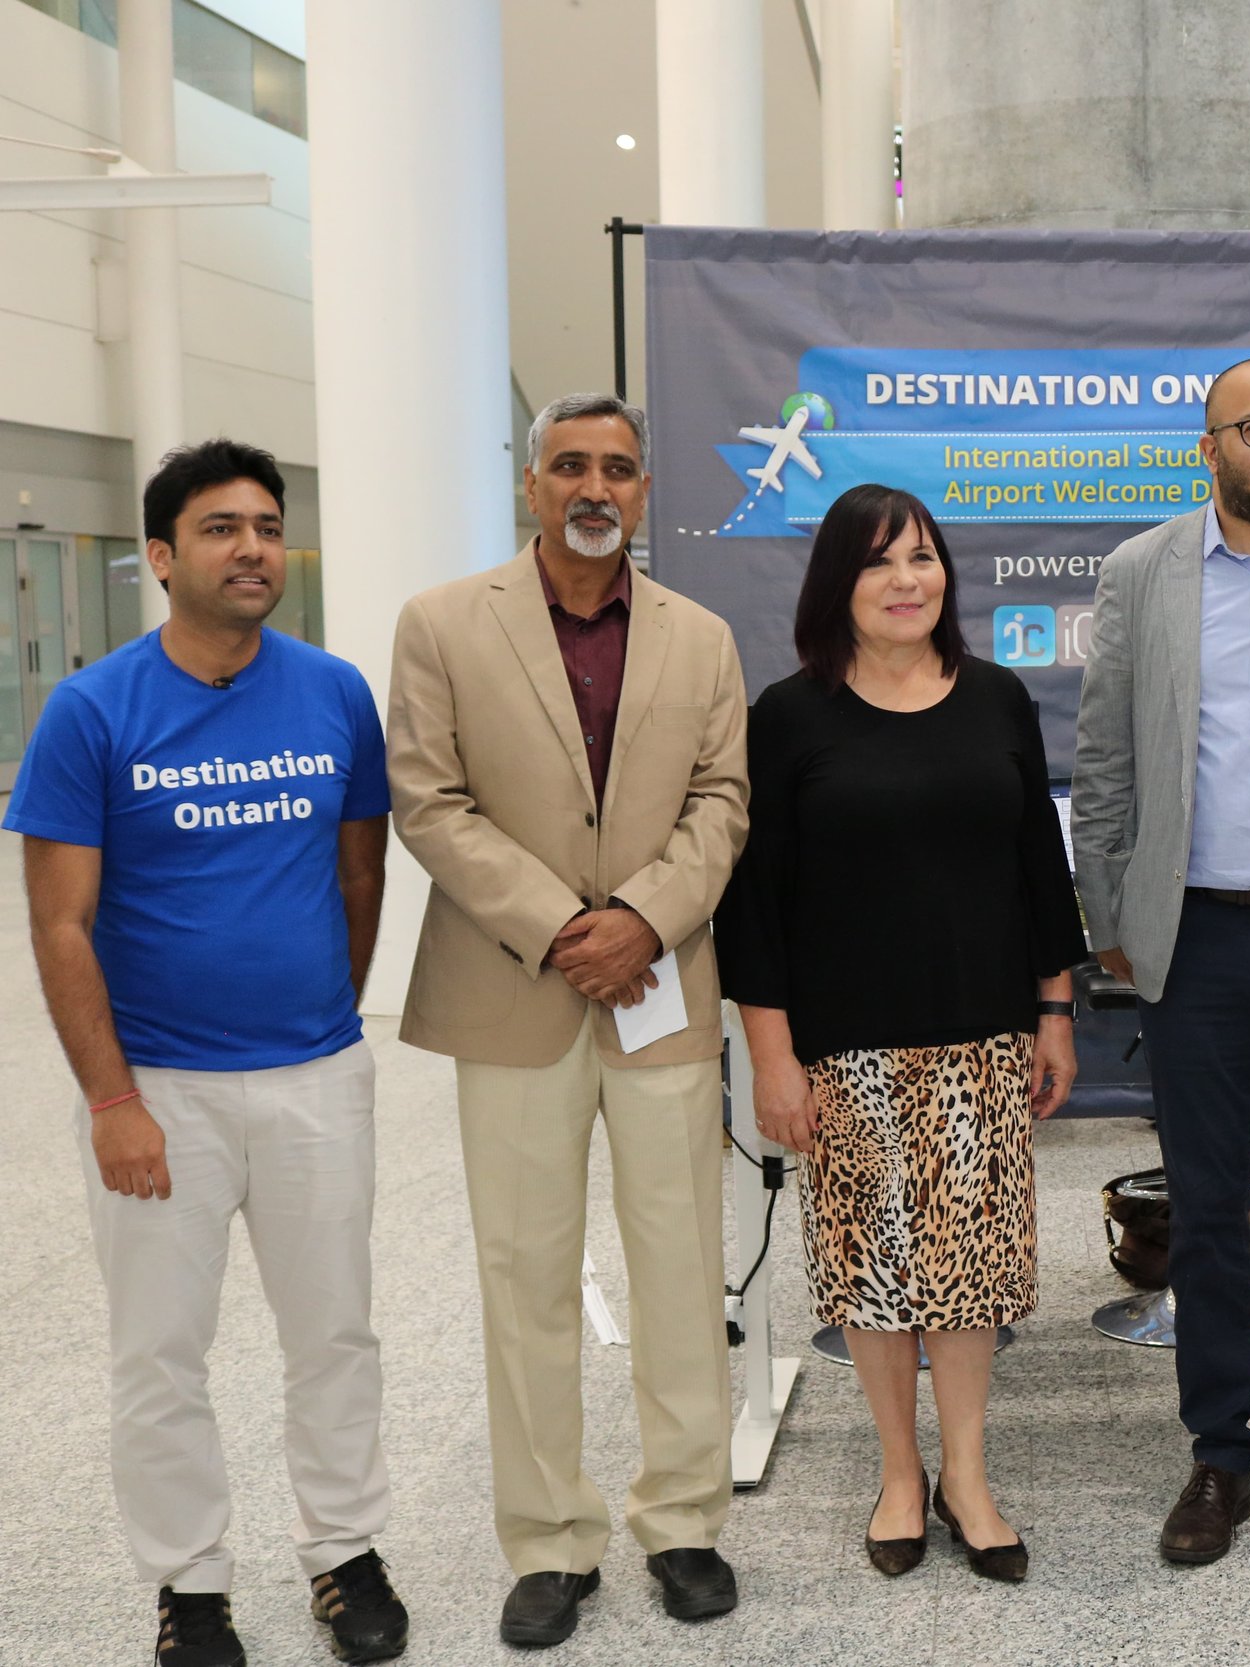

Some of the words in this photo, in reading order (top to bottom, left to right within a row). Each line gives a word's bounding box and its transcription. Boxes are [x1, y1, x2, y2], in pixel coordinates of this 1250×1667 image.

[866, 373, 1139, 405] DESTINATION
[945, 444, 1128, 469] International
[1138, 444, 1208, 468] Stud
[943, 480, 1045, 510] Airport
[1052, 479, 1182, 503] Welcome
[994, 555, 1102, 585] power
[132, 750, 335, 791] Destination
[174, 792, 313, 830] Ontario
